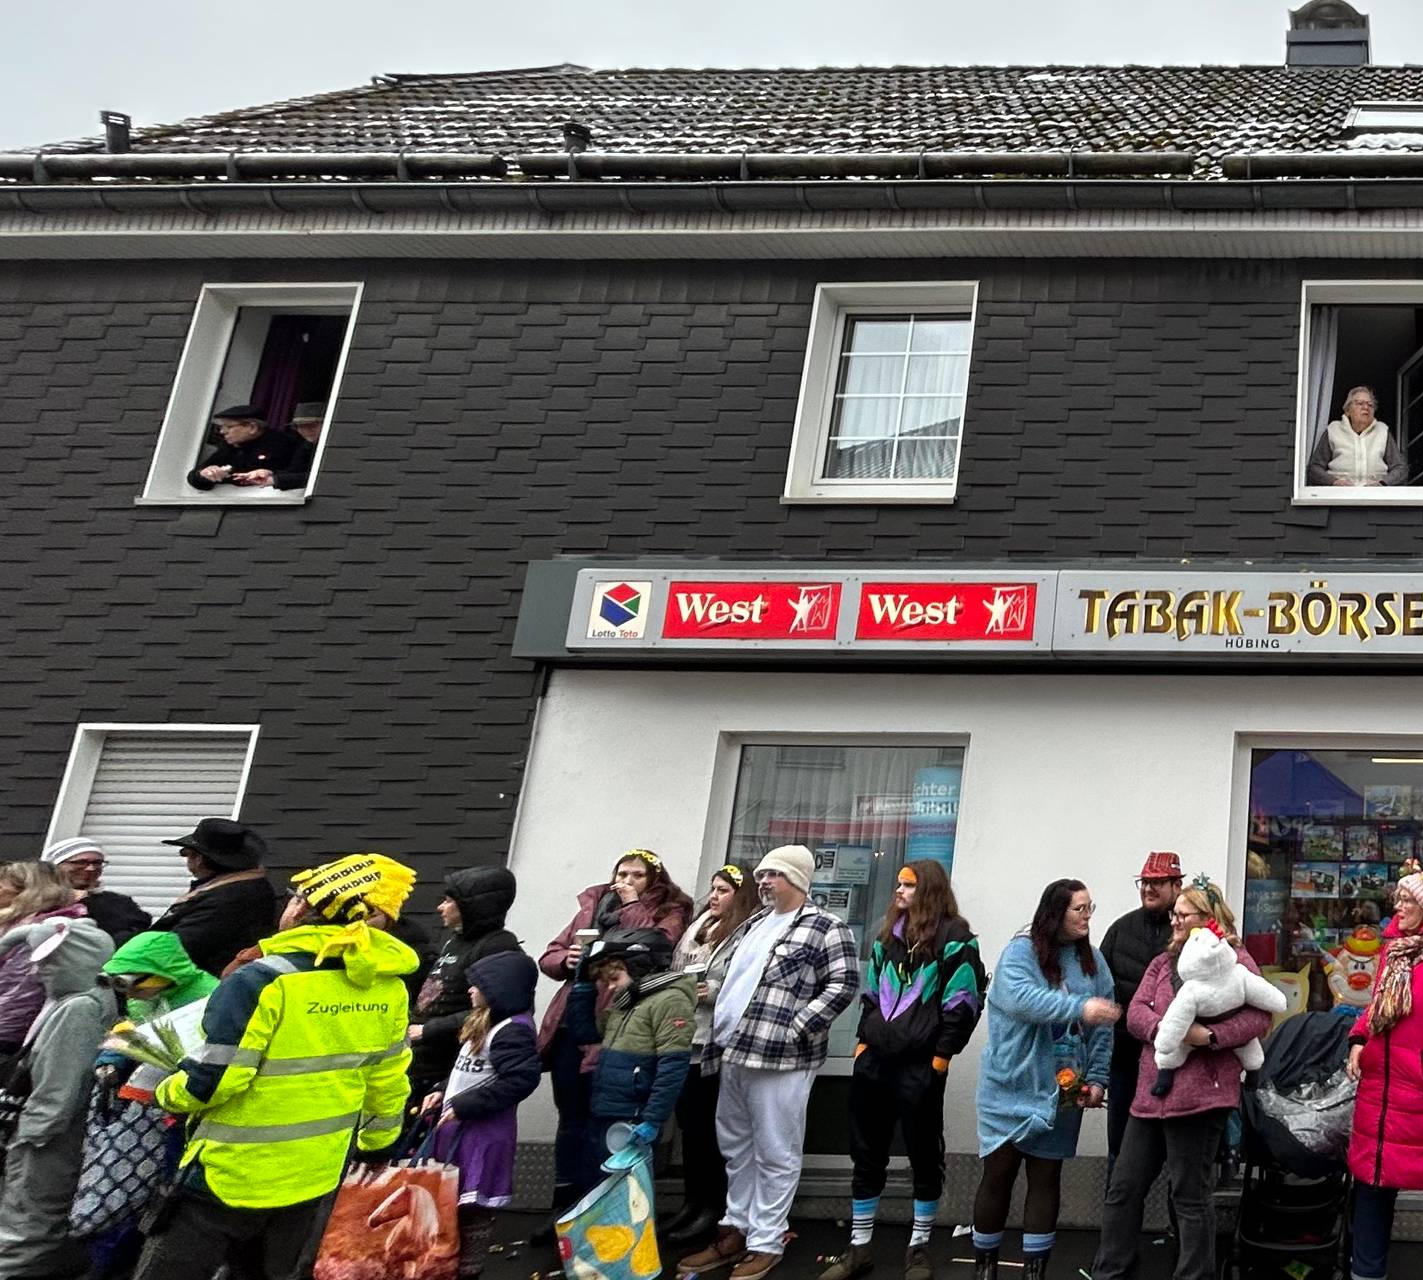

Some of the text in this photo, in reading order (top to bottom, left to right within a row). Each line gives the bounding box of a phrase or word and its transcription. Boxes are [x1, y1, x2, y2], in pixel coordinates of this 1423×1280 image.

[675, 592, 764, 625] West
[868, 593, 959, 625] West
[592, 629, 639, 638] Lotto Toto
[1225, 636, 1280, 649] HÜBING
[306, 1002, 389, 1017] Zugleitung
